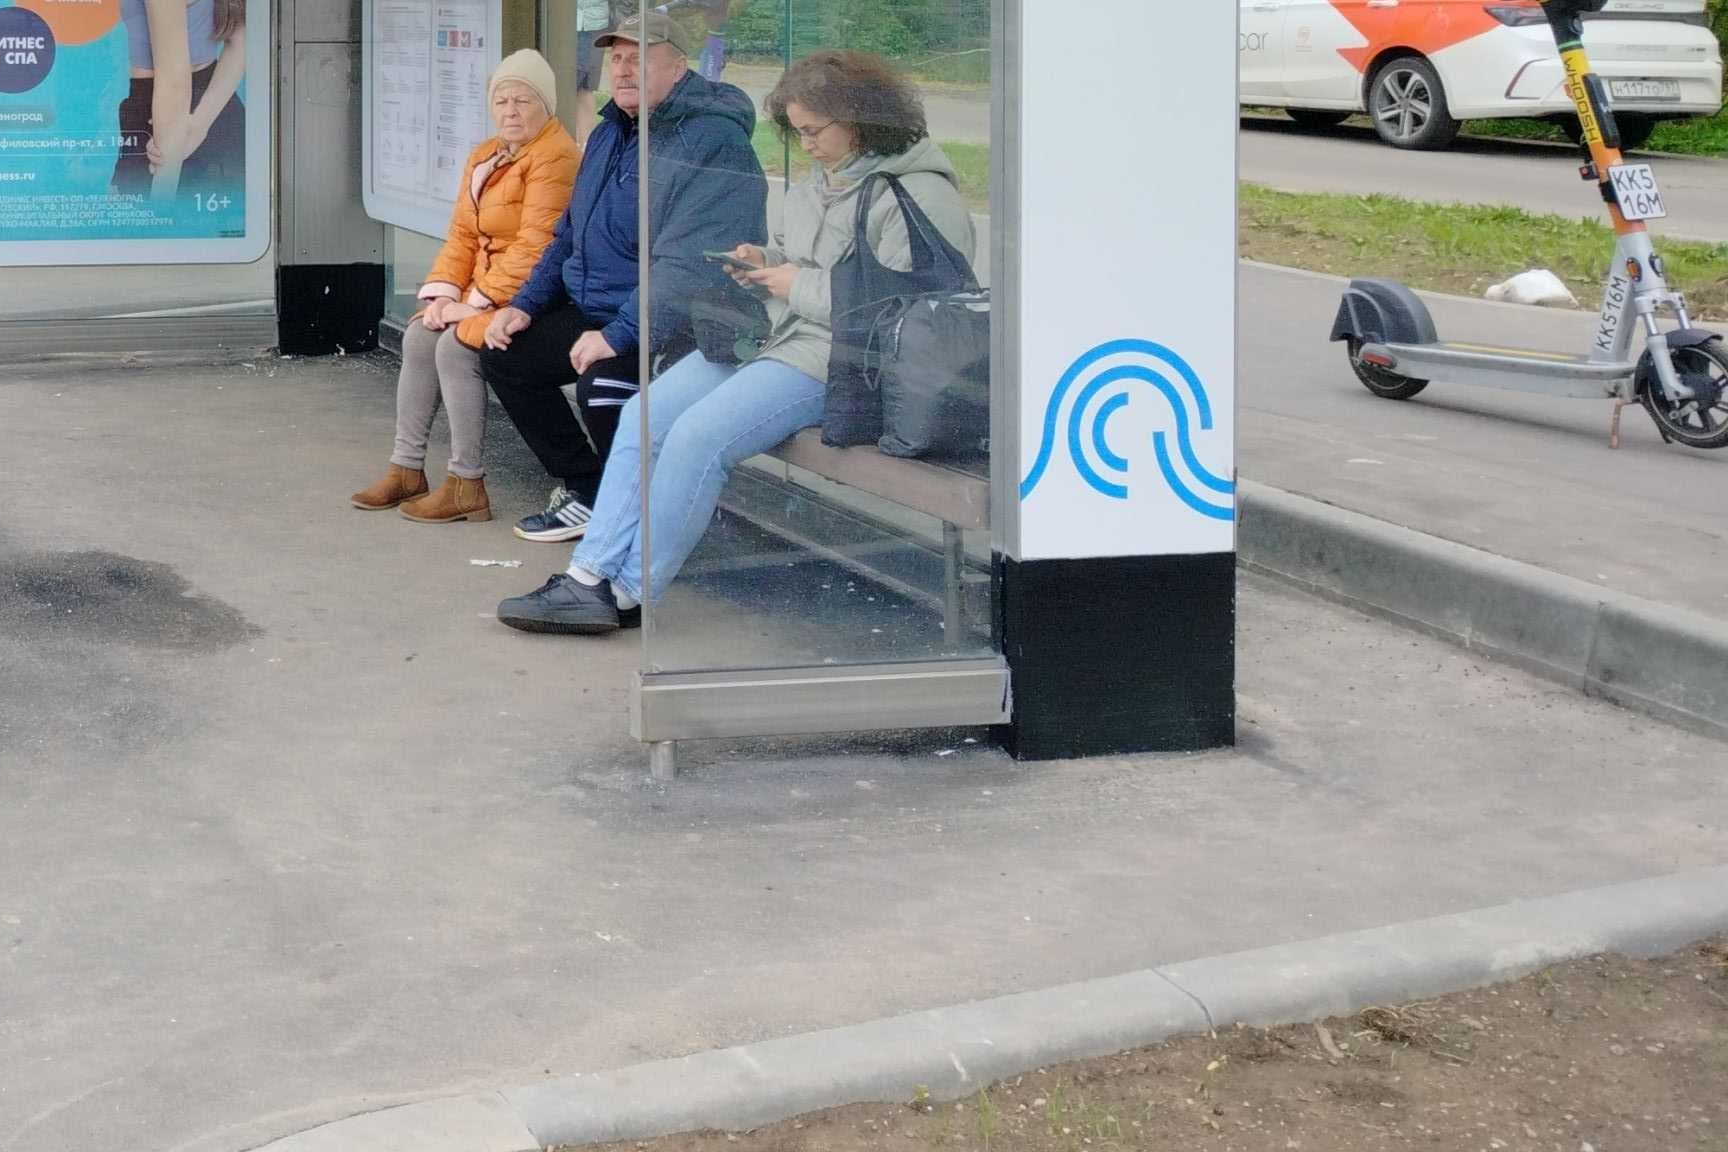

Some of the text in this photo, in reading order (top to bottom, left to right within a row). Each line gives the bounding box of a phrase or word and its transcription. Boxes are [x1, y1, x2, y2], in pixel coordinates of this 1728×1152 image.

[5, 53, 38, 64] СПА
[1564, 57, 1599, 143] WHOOSH
[111, 136, 138, 147] 1841
[1612, 168, 1654, 192] KK5
[193, 192, 232, 212] 16+
[1624, 194, 1665, 217] 16M
[1596, 276, 1627, 351] KK516M
